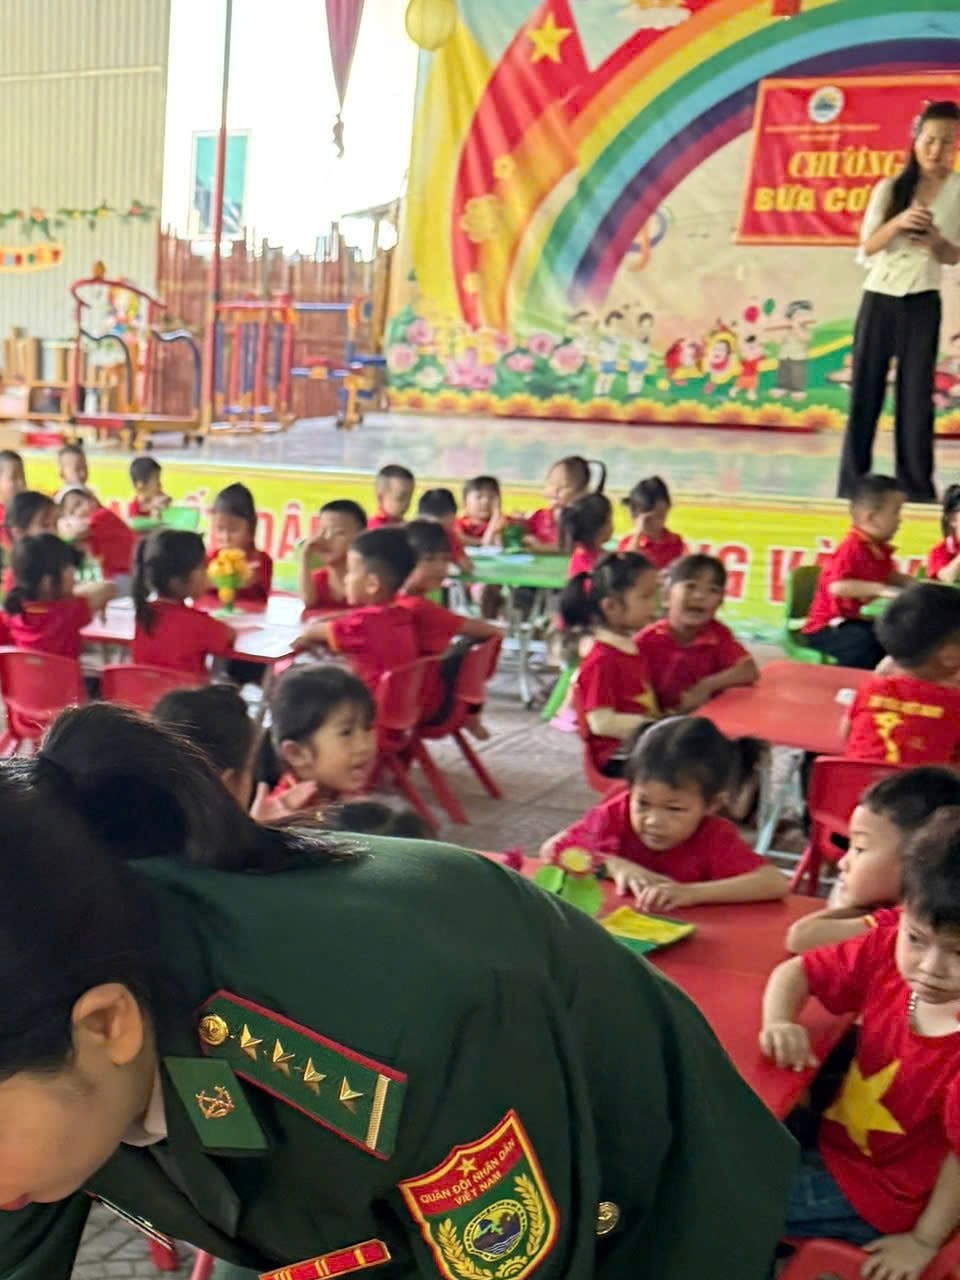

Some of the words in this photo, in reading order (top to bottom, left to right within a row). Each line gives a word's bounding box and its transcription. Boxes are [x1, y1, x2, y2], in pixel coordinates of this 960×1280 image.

[419, 1188, 452, 1204] QUÂN
[472, 1157, 500, 1184] NHÂN
[479, 1170, 502, 1193] NAM
